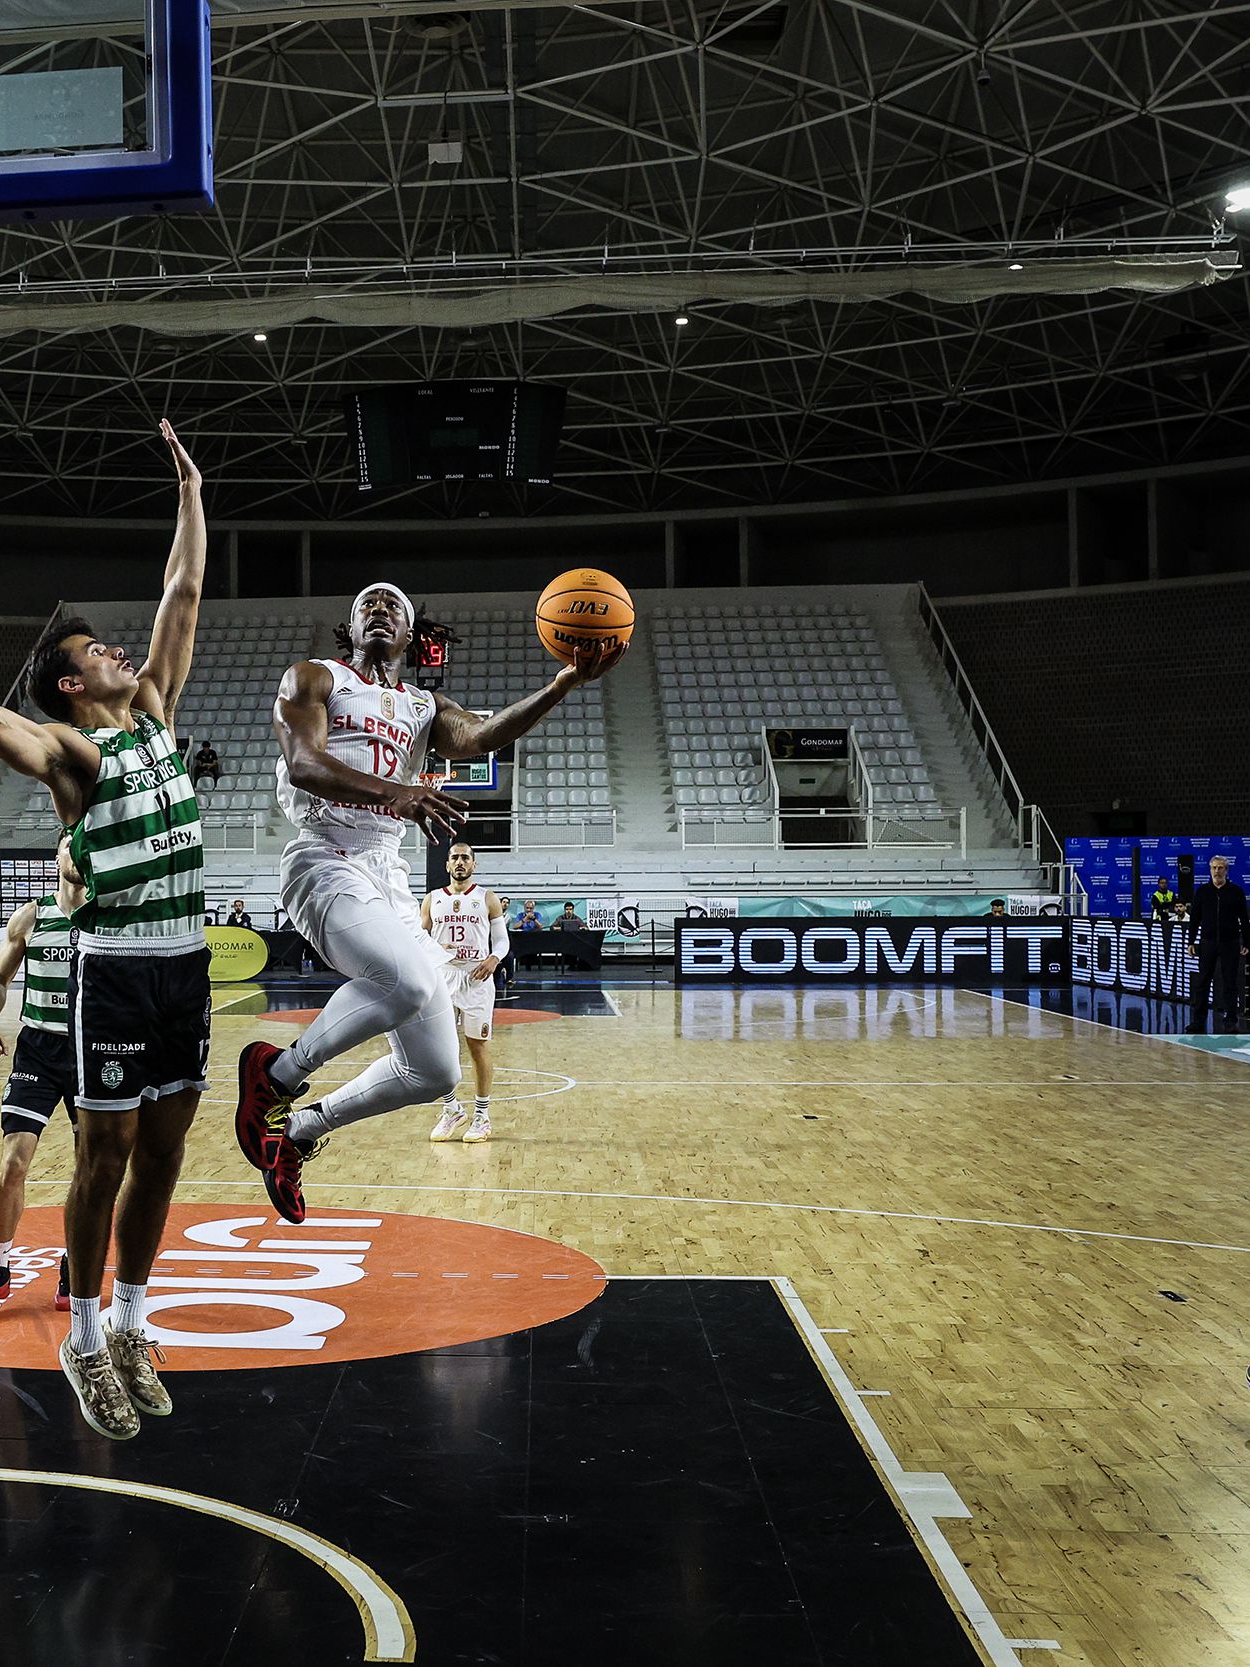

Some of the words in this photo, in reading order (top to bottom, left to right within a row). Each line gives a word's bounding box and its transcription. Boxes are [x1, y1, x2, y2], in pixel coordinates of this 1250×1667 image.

[332, 714, 357, 731] SL
[364, 716, 415, 752] BENFI
[801, 738, 843, 746] GONDOMAR
[367, 739, 399, 778] 19
[853, 900, 872, 910] TAÇA
[1011, 905, 1029, 915] HUGO
[590, 909, 607, 918] HUGO
[710, 908, 728, 917] HUGO
[444, 915, 479, 925] BENFICA
[590, 919, 616, 928] SANTOS
[449, 926, 465, 942] 13
[43, 948, 77, 961] SPOR
[91, 1043, 146, 1051] FIDELIDADE
